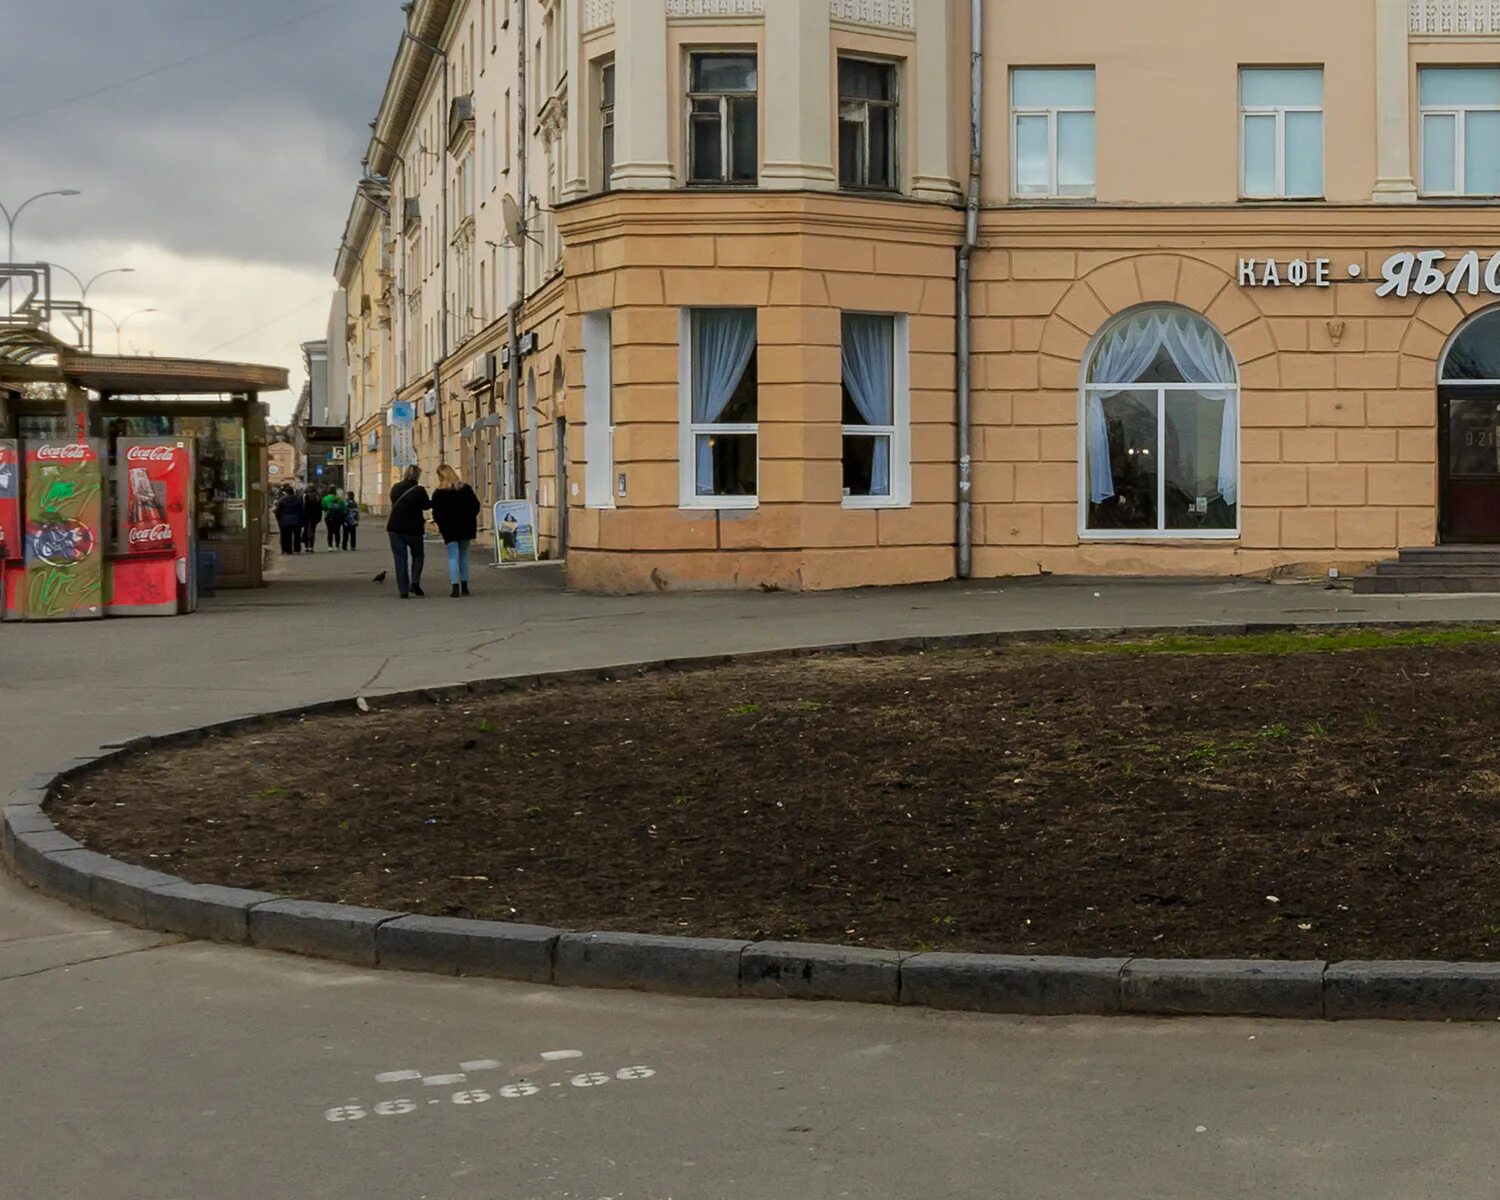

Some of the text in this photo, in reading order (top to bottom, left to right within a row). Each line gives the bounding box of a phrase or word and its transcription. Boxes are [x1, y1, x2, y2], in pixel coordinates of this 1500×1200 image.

[1237, 257, 1331, 287] КАФЕ
[37, 444, 88, 460] Coca-Cola
[127, 445, 174, 461] Coca-Cola
[129, 523, 173, 544] Coca-Cola
